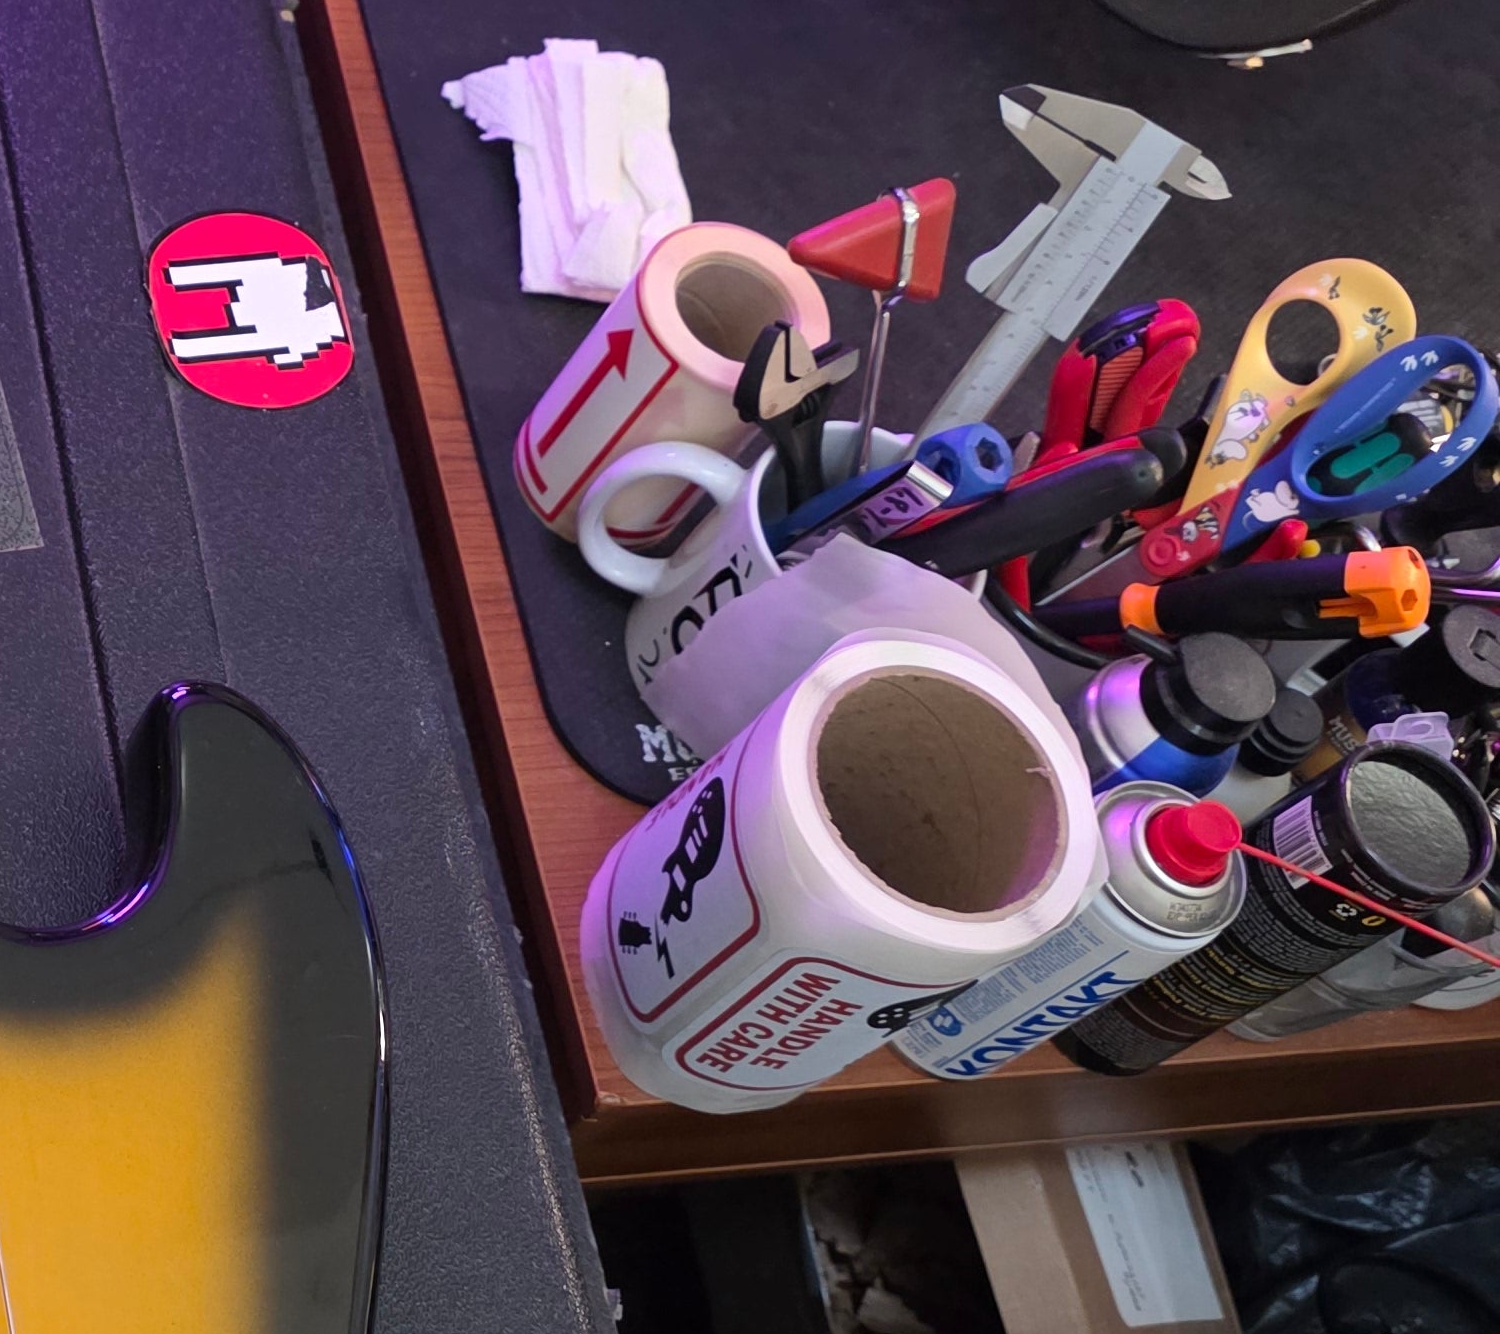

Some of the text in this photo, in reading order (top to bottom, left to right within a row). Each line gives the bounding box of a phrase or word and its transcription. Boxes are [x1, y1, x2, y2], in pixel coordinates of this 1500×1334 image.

[696, 972, 842, 1073] WITH CARE
[749, 998, 864, 1070] HANDLE
[945, 970, 1144, 1077] KONTAKT
